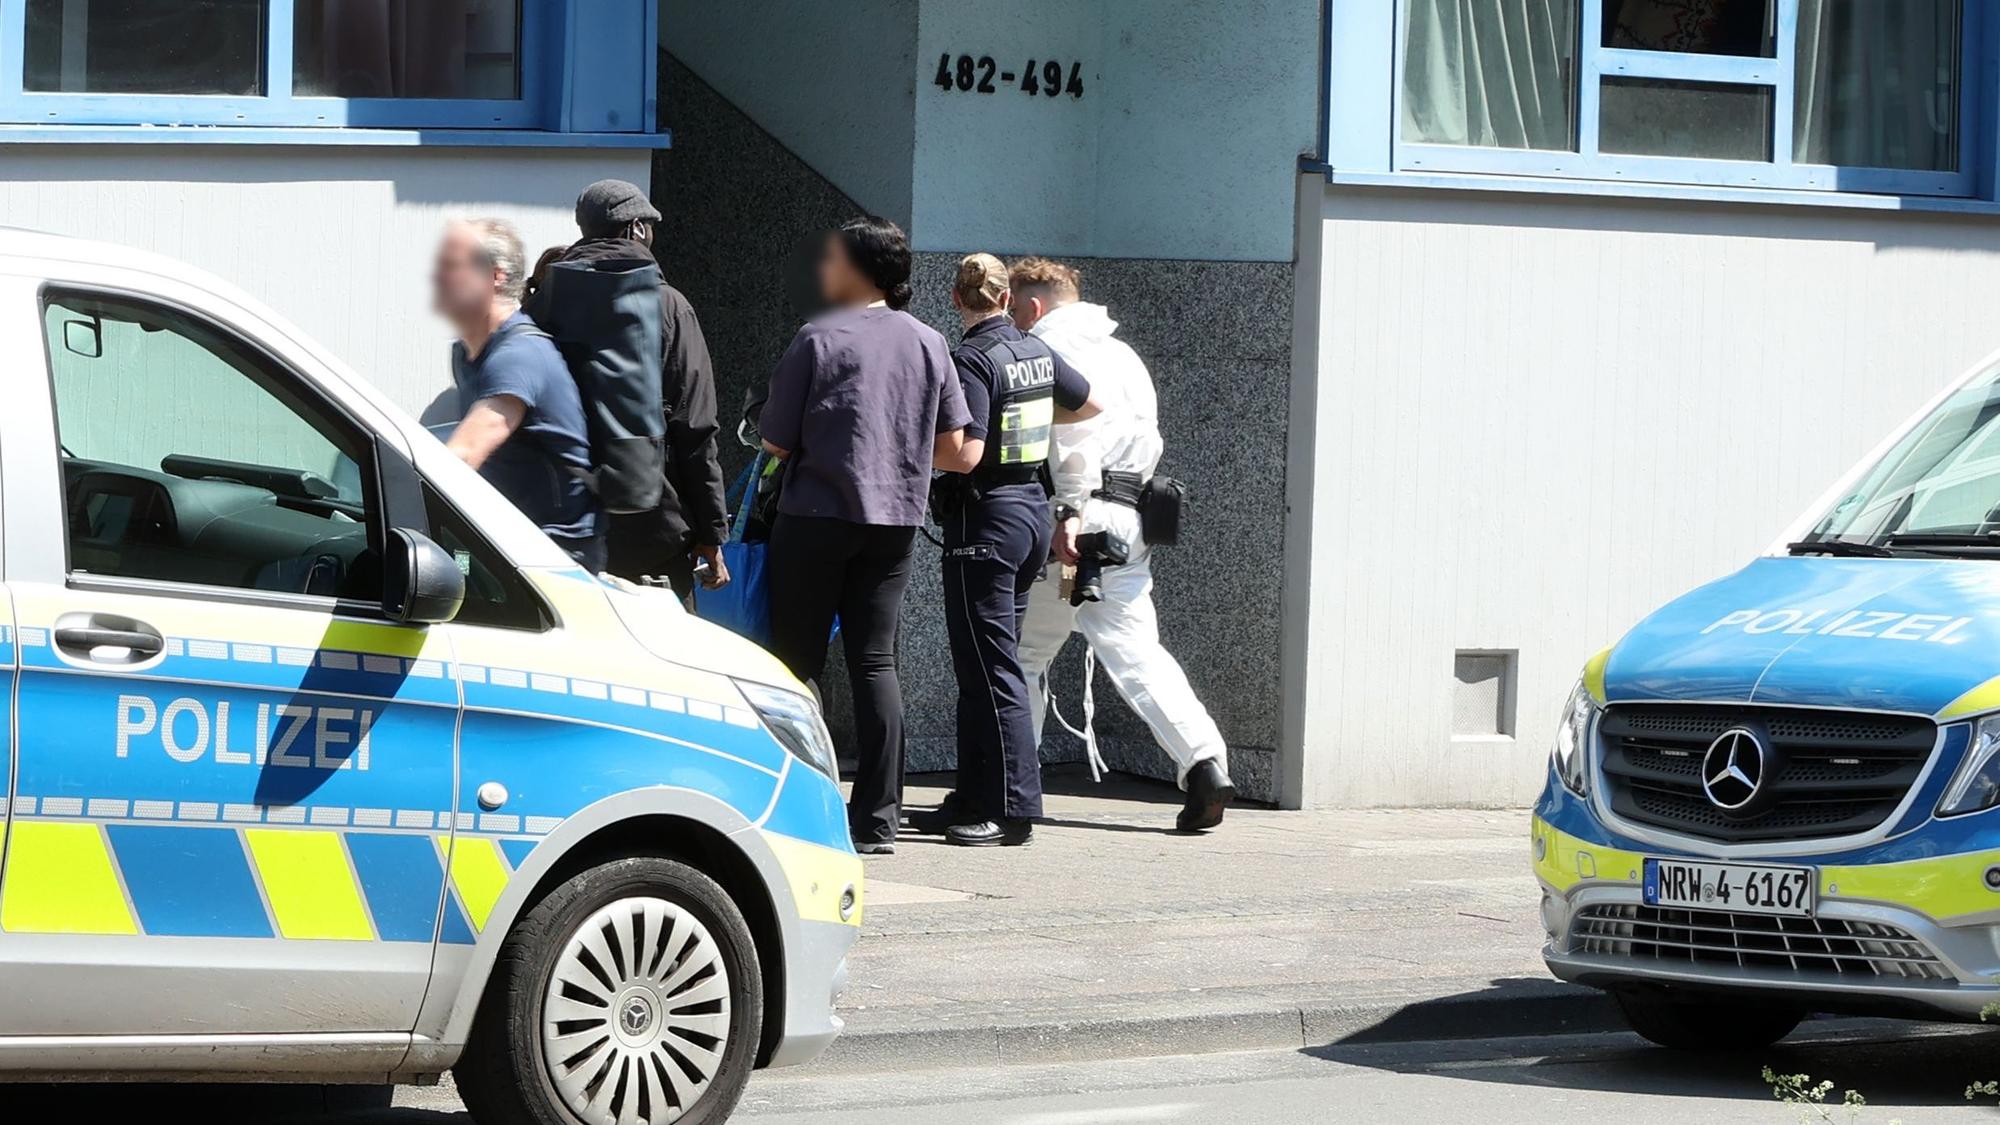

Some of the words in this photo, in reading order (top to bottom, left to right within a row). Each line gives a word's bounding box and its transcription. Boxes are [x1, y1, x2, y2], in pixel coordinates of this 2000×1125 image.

[935, 53, 1084, 98] 482-494
[1701, 609, 1973, 644] POLIZEI
[116, 694, 373, 770] POLIZEI
[1647, 886, 1654, 896] D
[1659, 865, 1701, 902] NRW
[1716, 870, 1809, 908] 4-6167
